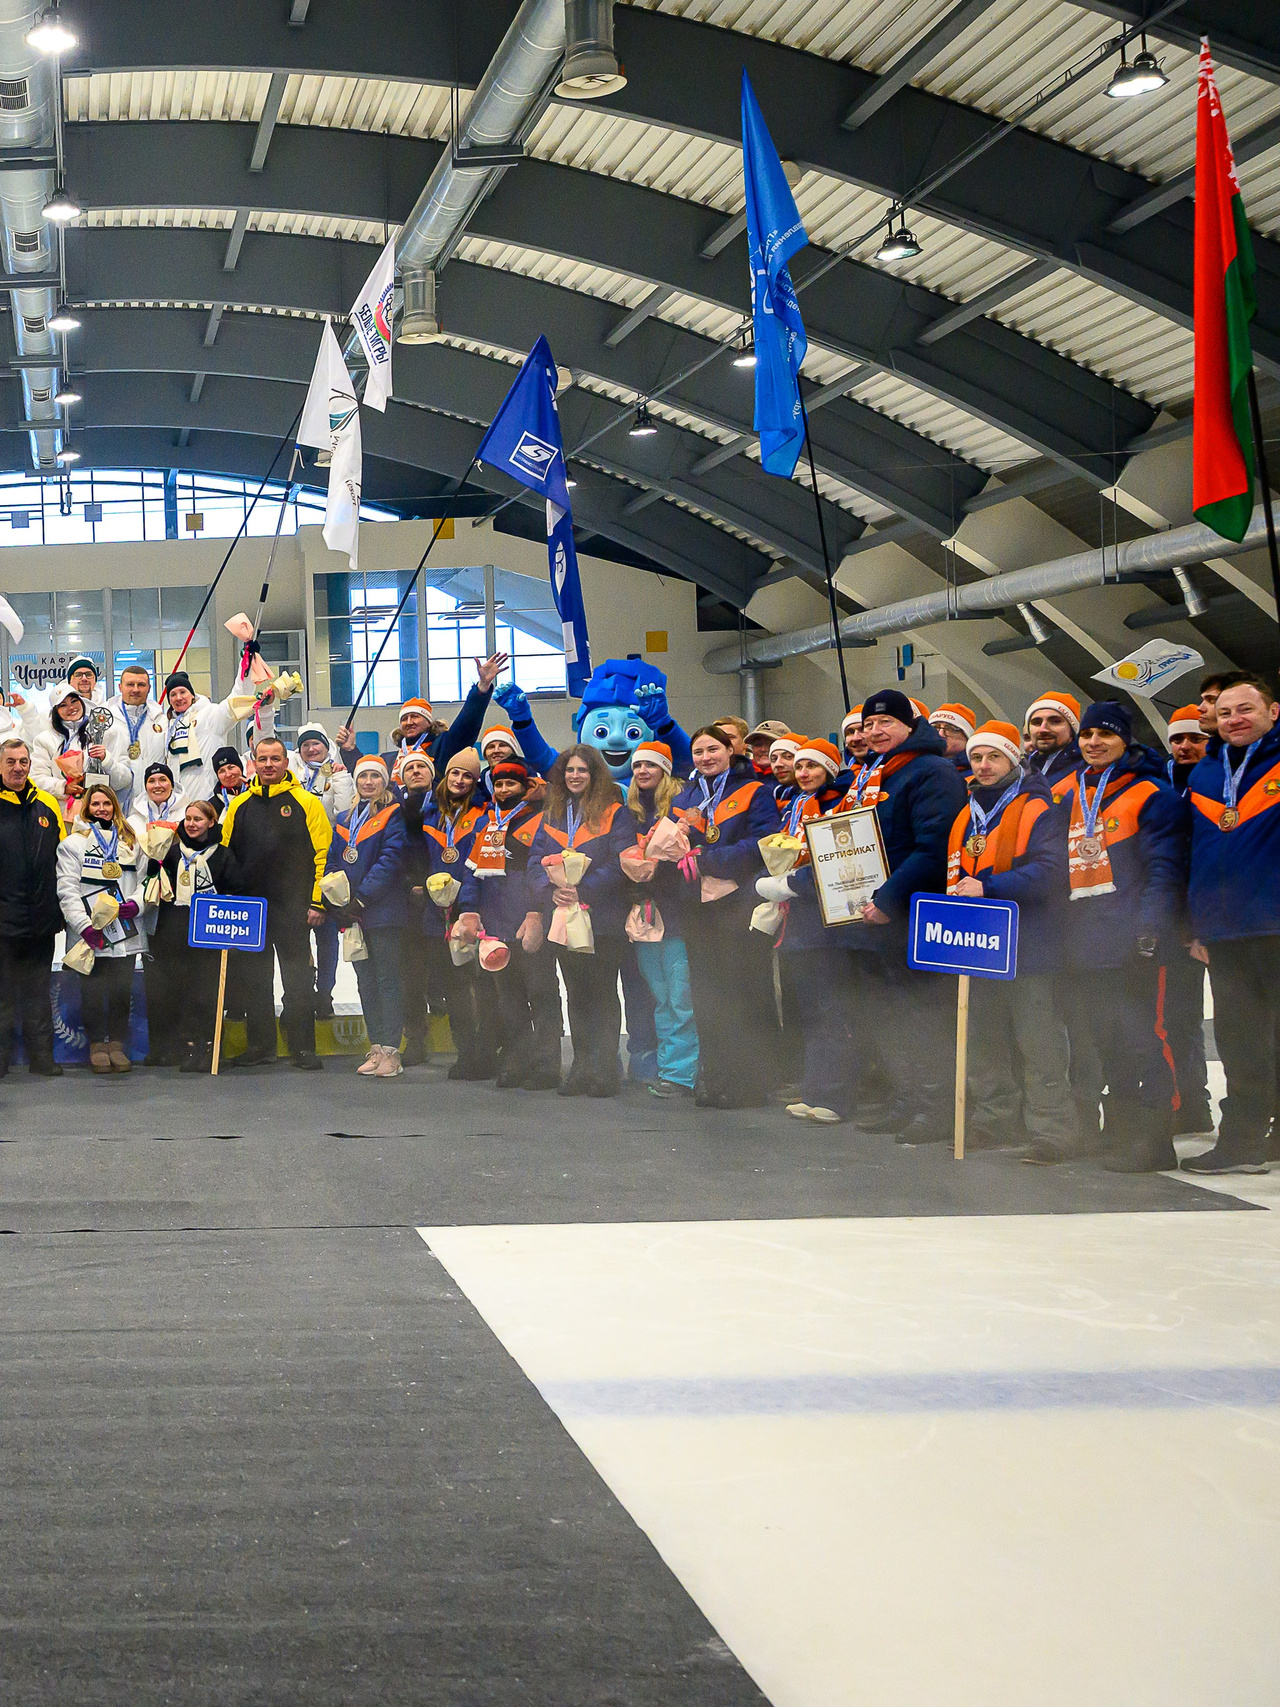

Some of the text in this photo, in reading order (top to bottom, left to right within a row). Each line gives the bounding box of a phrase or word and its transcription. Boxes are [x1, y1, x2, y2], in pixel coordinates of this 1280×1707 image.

[359, 303, 375, 336] БЕЛЫЕ
[369, 330, 389, 364] ТИГРЫ
[817, 843, 877, 863] СЕРТИФИКАТ
[208, 905, 249, 921] Белые
[205, 923, 249, 939] тигры
[925, 922, 1000, 951] Молния
